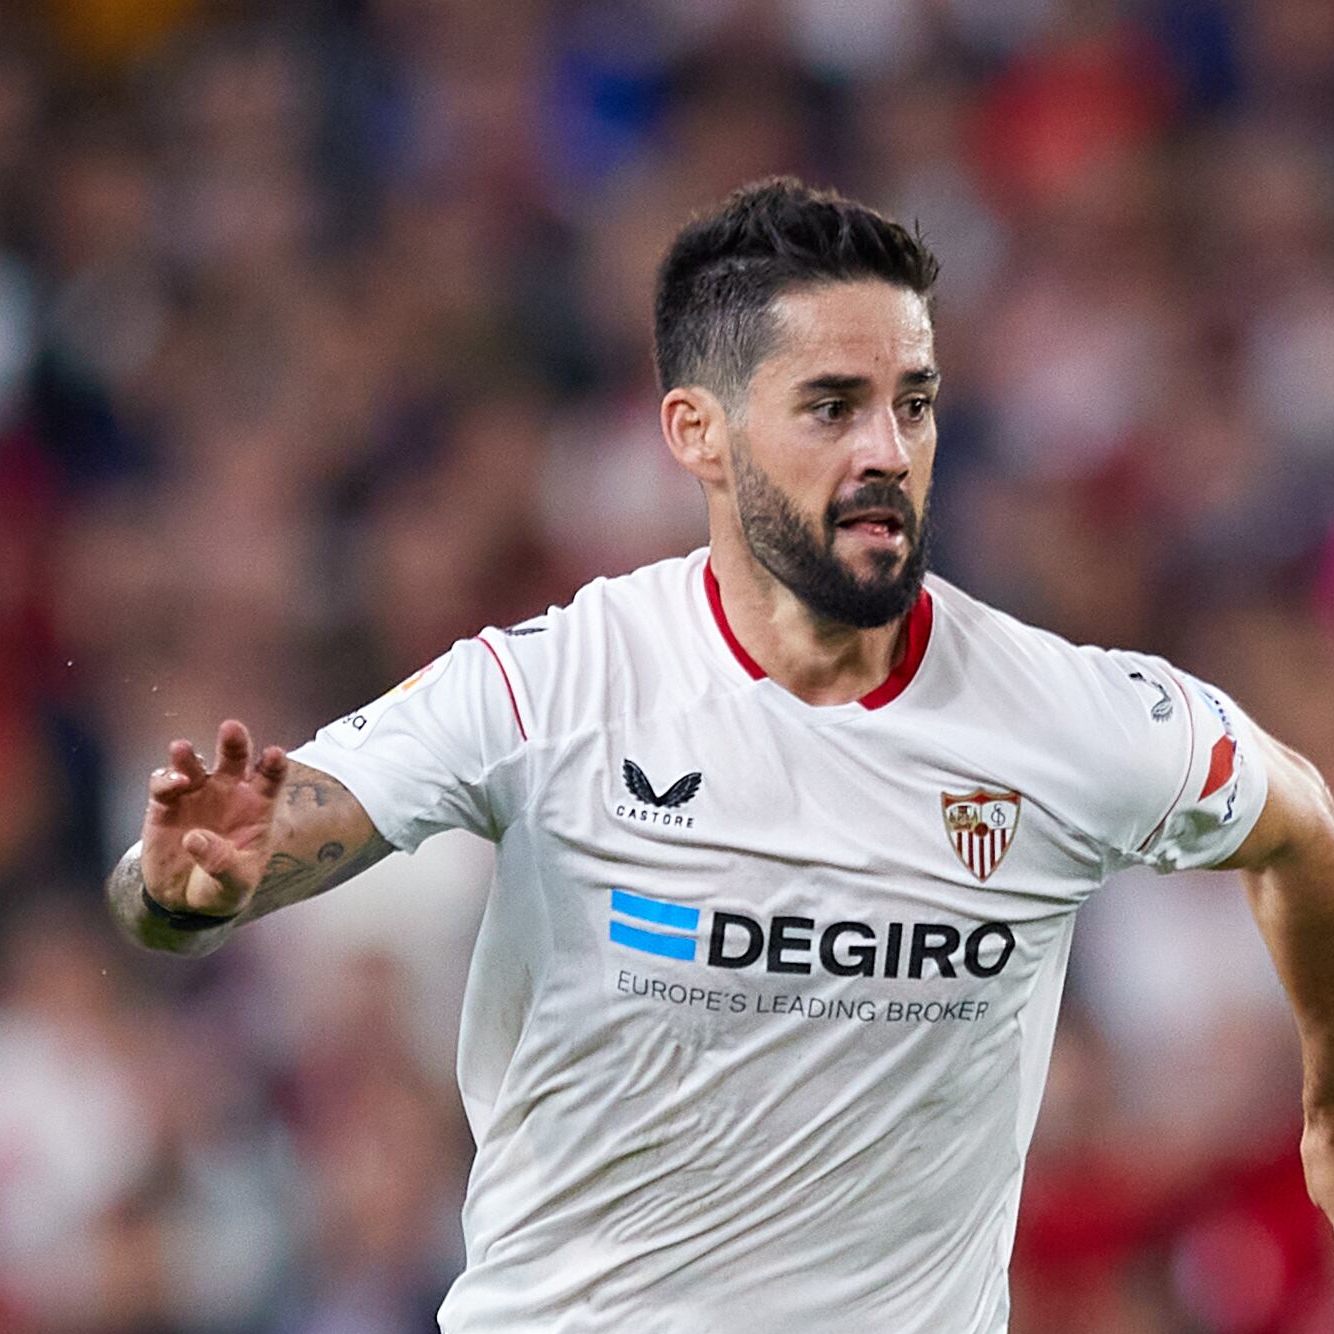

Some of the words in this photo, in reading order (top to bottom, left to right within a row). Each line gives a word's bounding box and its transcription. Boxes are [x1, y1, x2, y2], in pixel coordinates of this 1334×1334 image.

[616, 805, 694, 829] CASTORE
[707, 911, 1016, 979] DEGIRO
[617, 969, 747, 1014] EUROPE'S
[756, 993, 876, 1022] LEADING
[886, 1001, 990, 1024] BROKER
